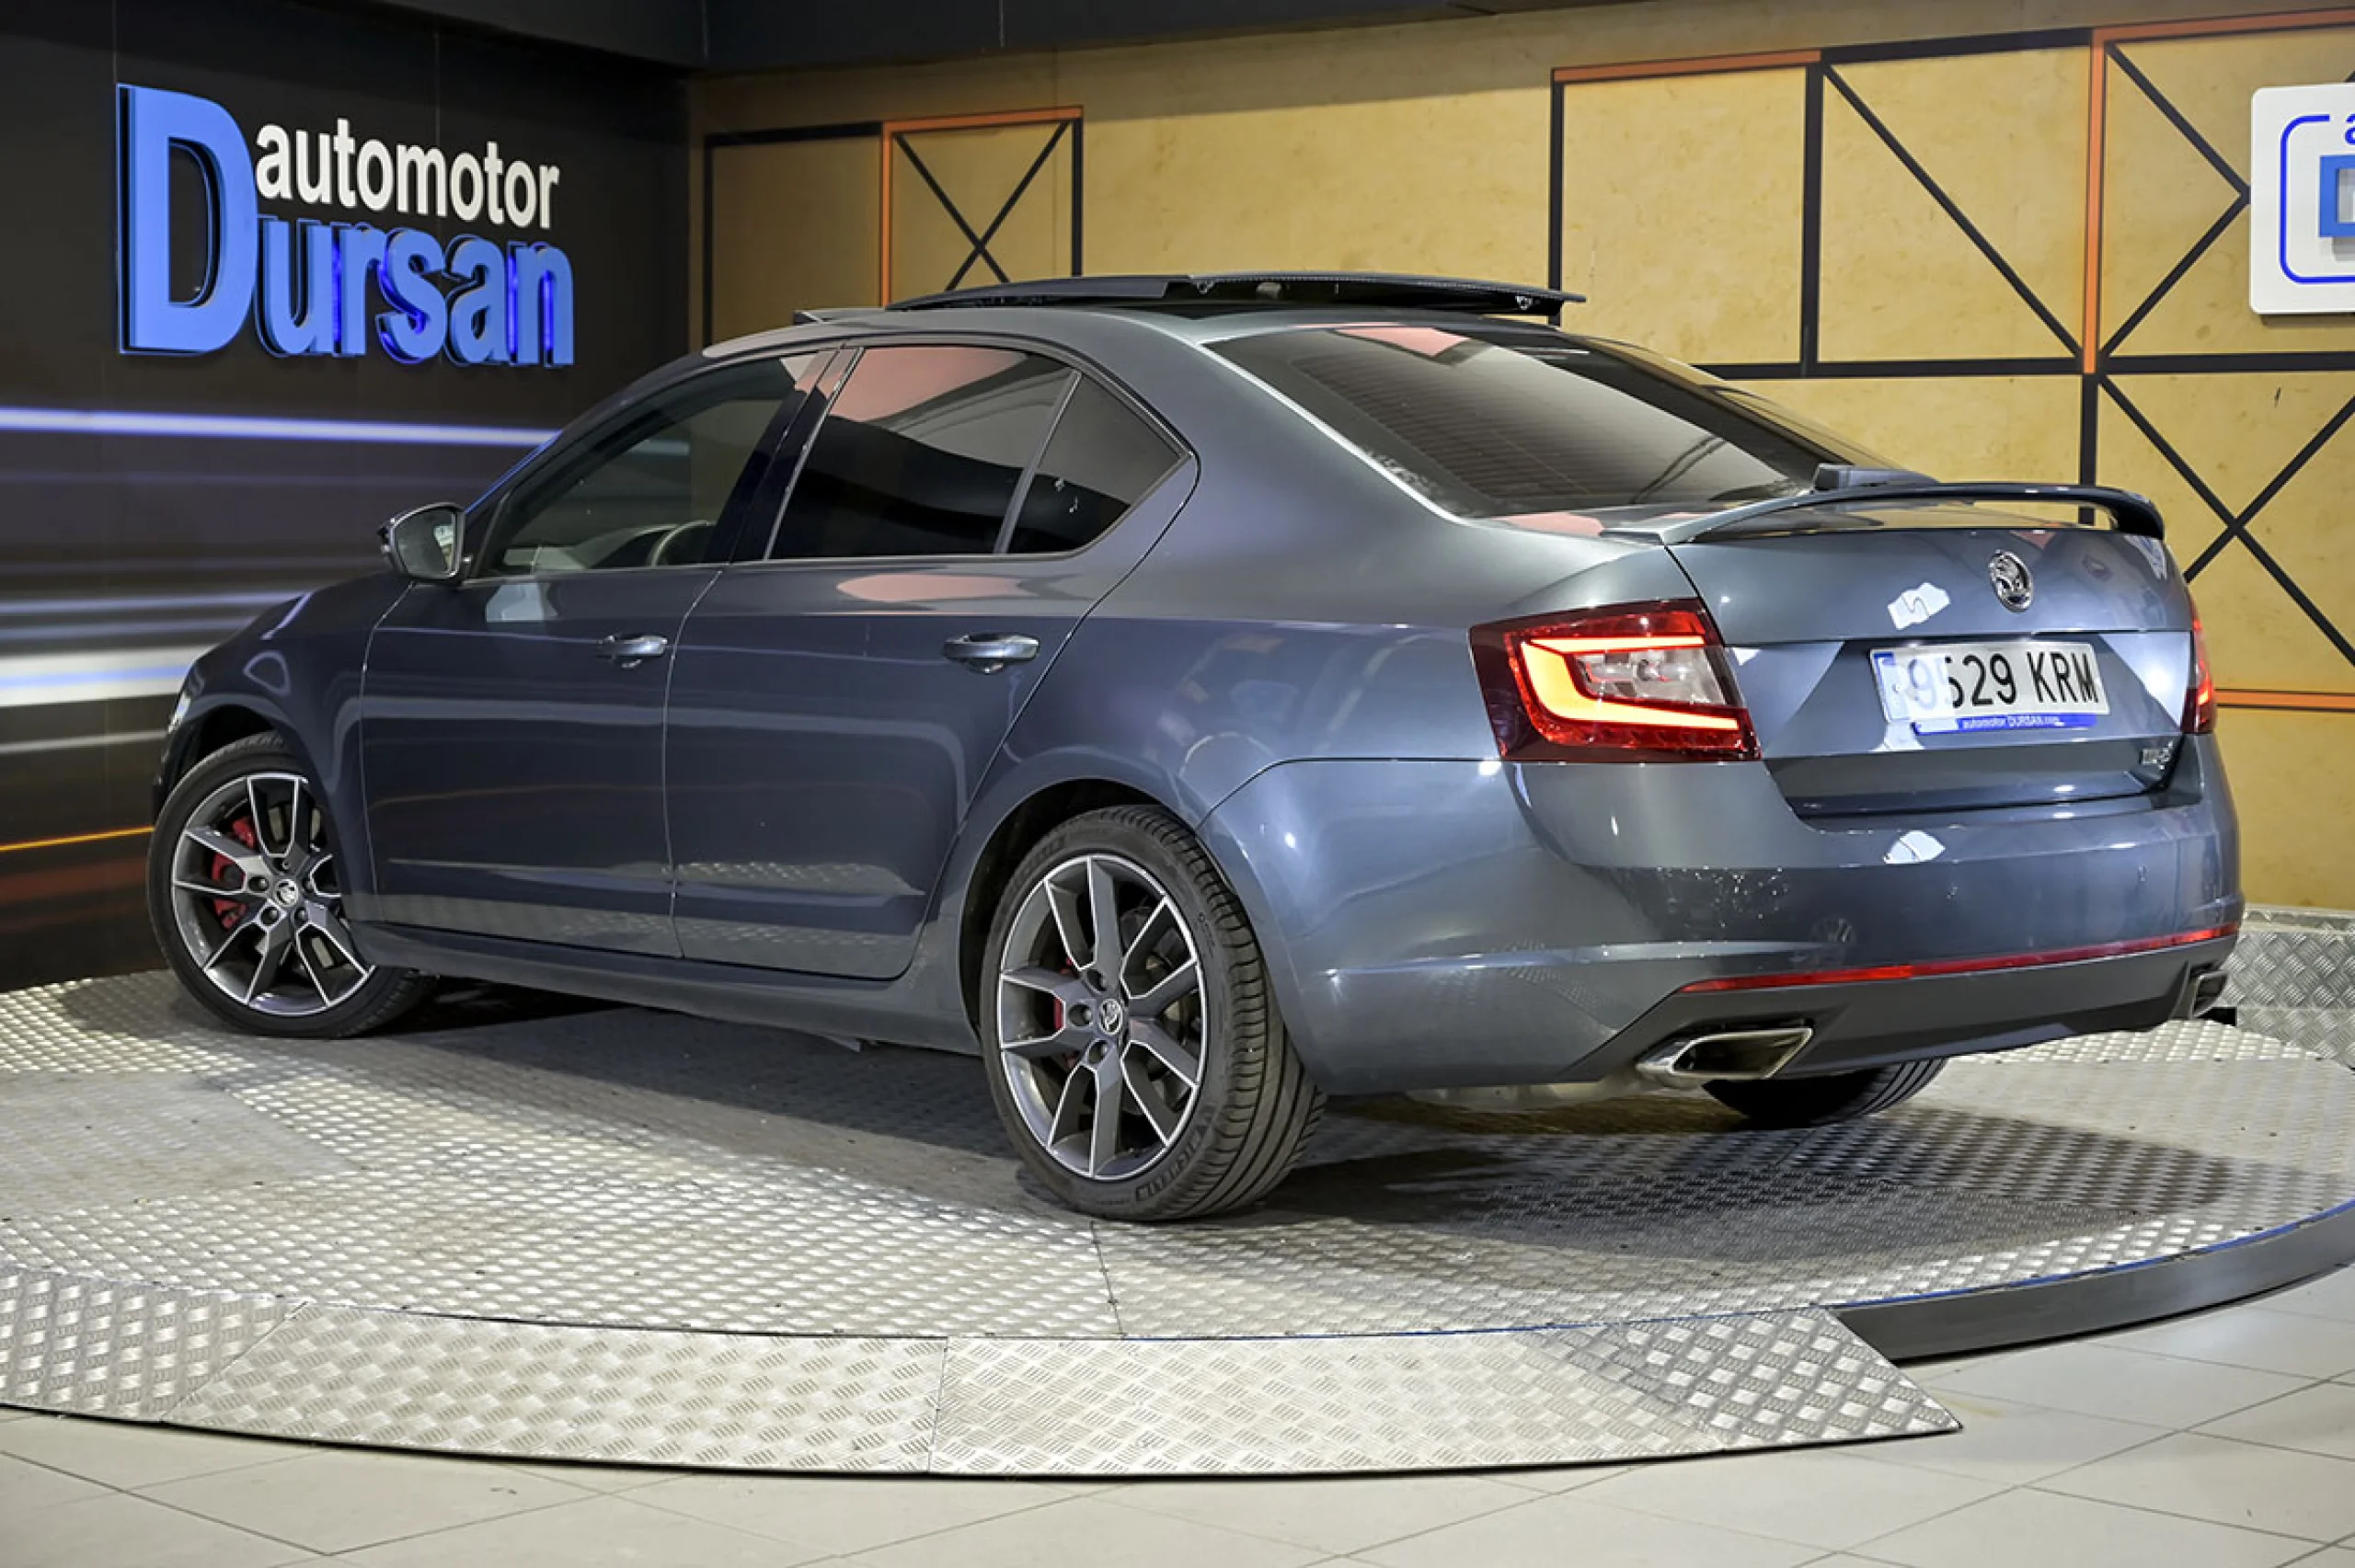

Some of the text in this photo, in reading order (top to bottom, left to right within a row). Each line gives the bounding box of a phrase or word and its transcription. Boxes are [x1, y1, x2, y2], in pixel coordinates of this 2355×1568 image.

[117, 83, 575, 368] Dursan
[254, 118, 560, 229] automotor
[2027, 651, 2099, 703] KRM
